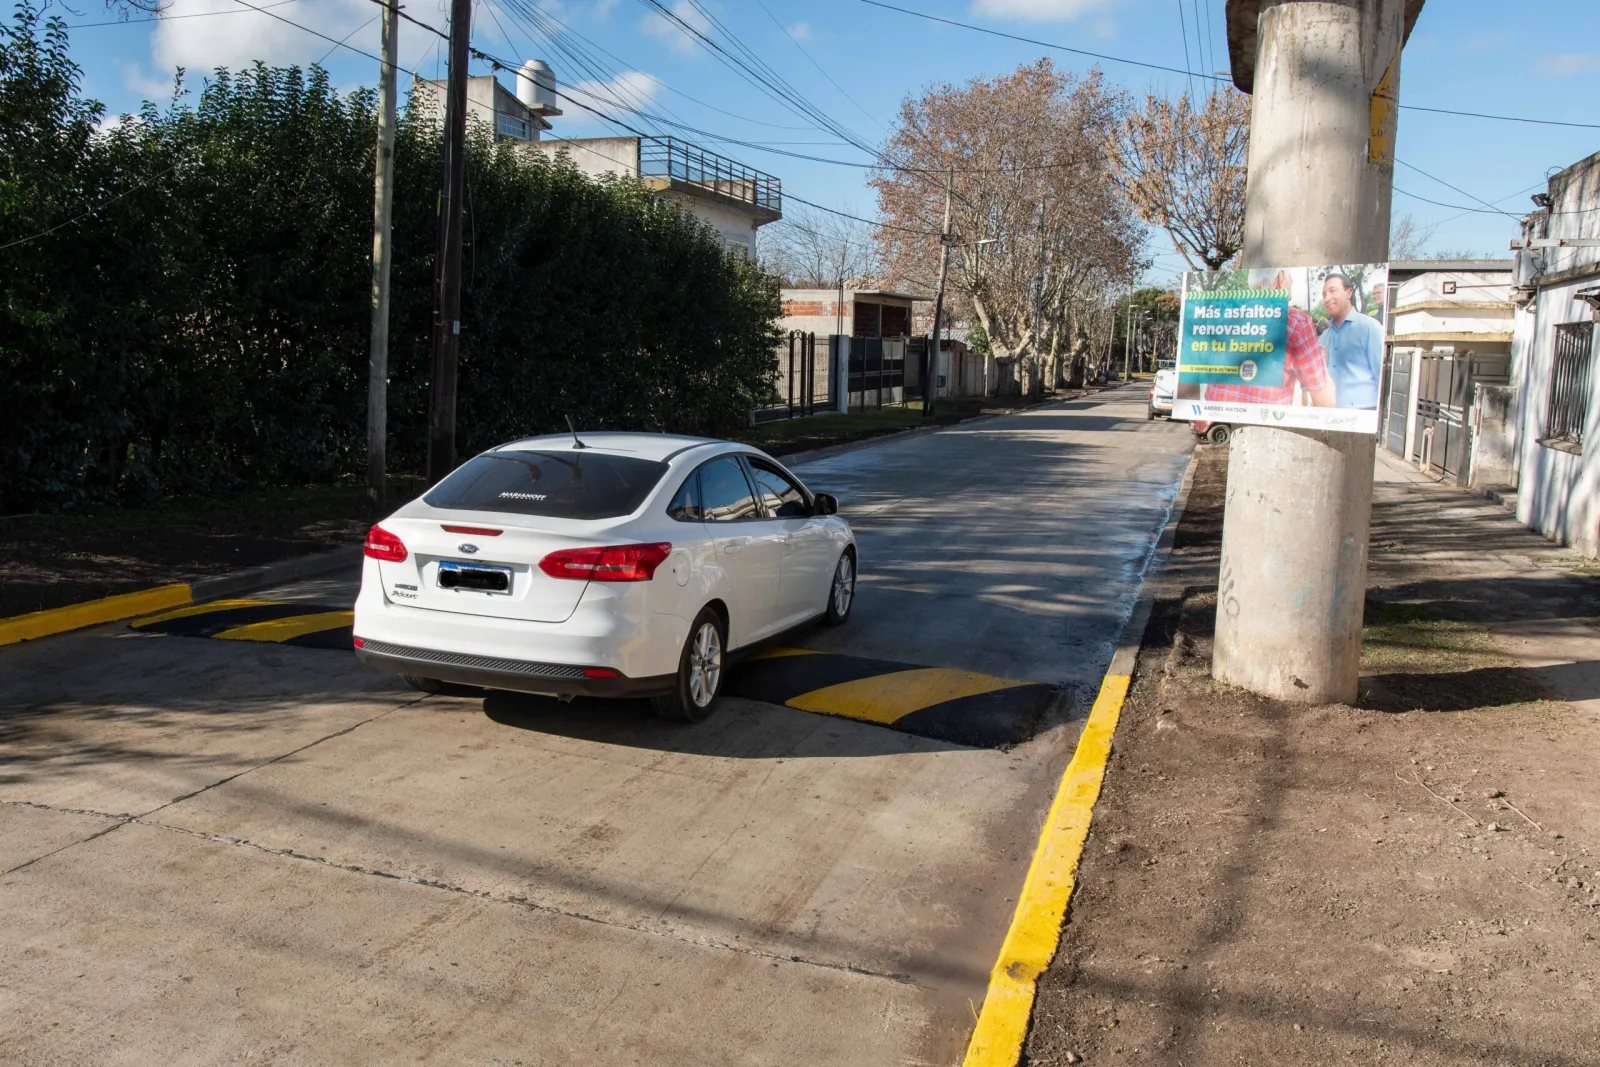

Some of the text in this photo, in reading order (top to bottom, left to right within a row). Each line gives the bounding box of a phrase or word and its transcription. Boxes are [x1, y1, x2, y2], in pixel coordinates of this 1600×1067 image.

[1193, 304, 1282, 319] Más asfaltos
[1192, 321, 1268, 336] renovados
[1191, 338, 1275, 353] en tu barrio
